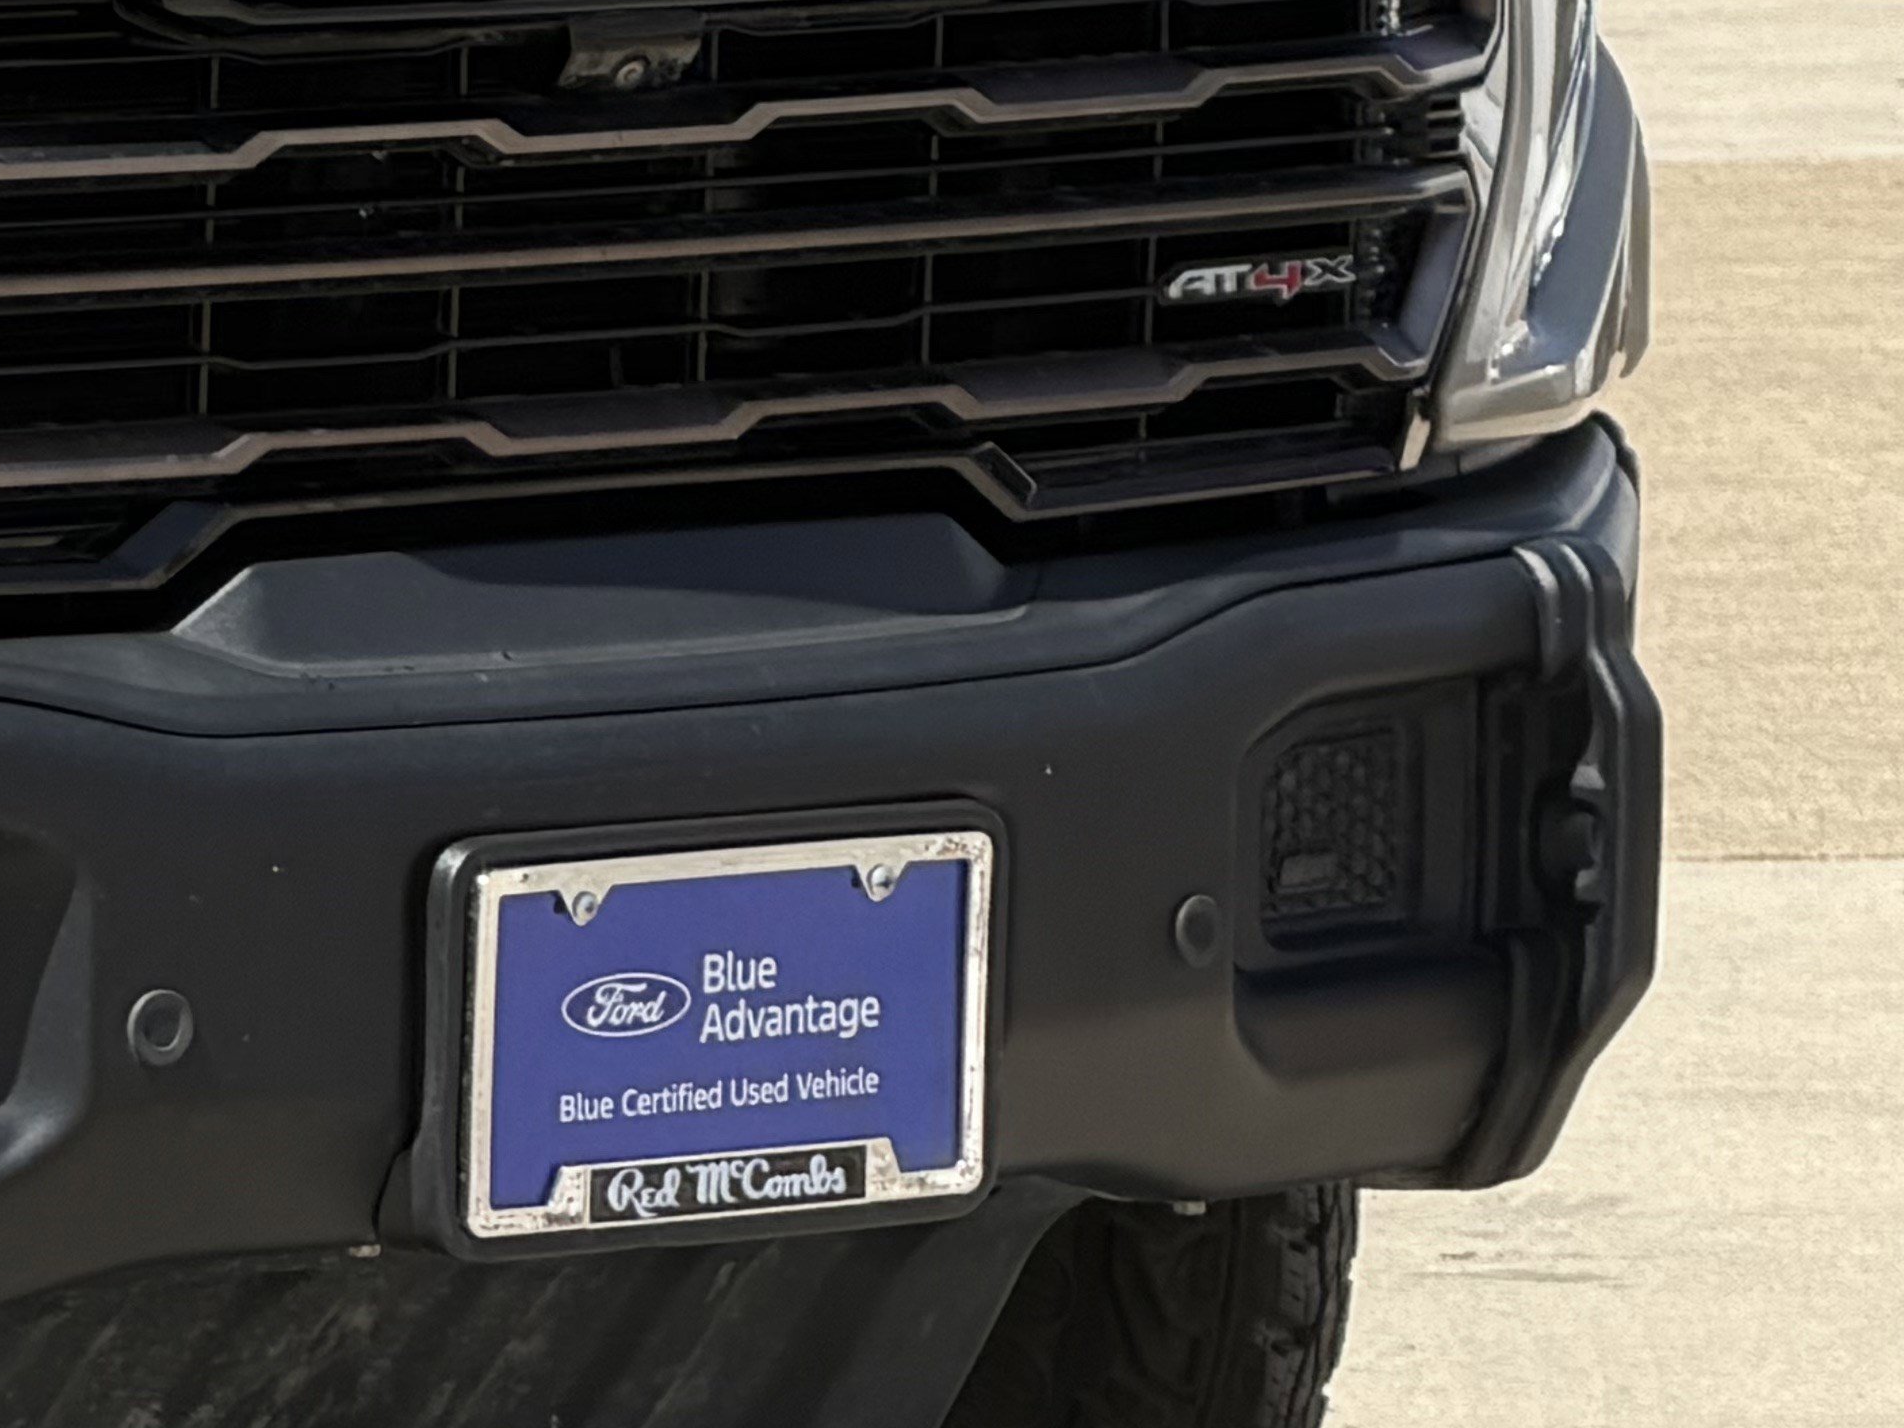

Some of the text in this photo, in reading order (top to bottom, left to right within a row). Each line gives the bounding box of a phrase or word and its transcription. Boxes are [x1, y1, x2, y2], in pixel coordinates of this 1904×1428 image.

[1168, 254, 1356, 300] AT4X
[702, 950, 777, 994] Blue
[586, 982, 666, 1028] Ford
[700, 996, 881, 1044] Advantage
[559, 1066, 880, 1122] Blue Certified Used Vehicle
[686, 1153, 848, 1205] McCombs
